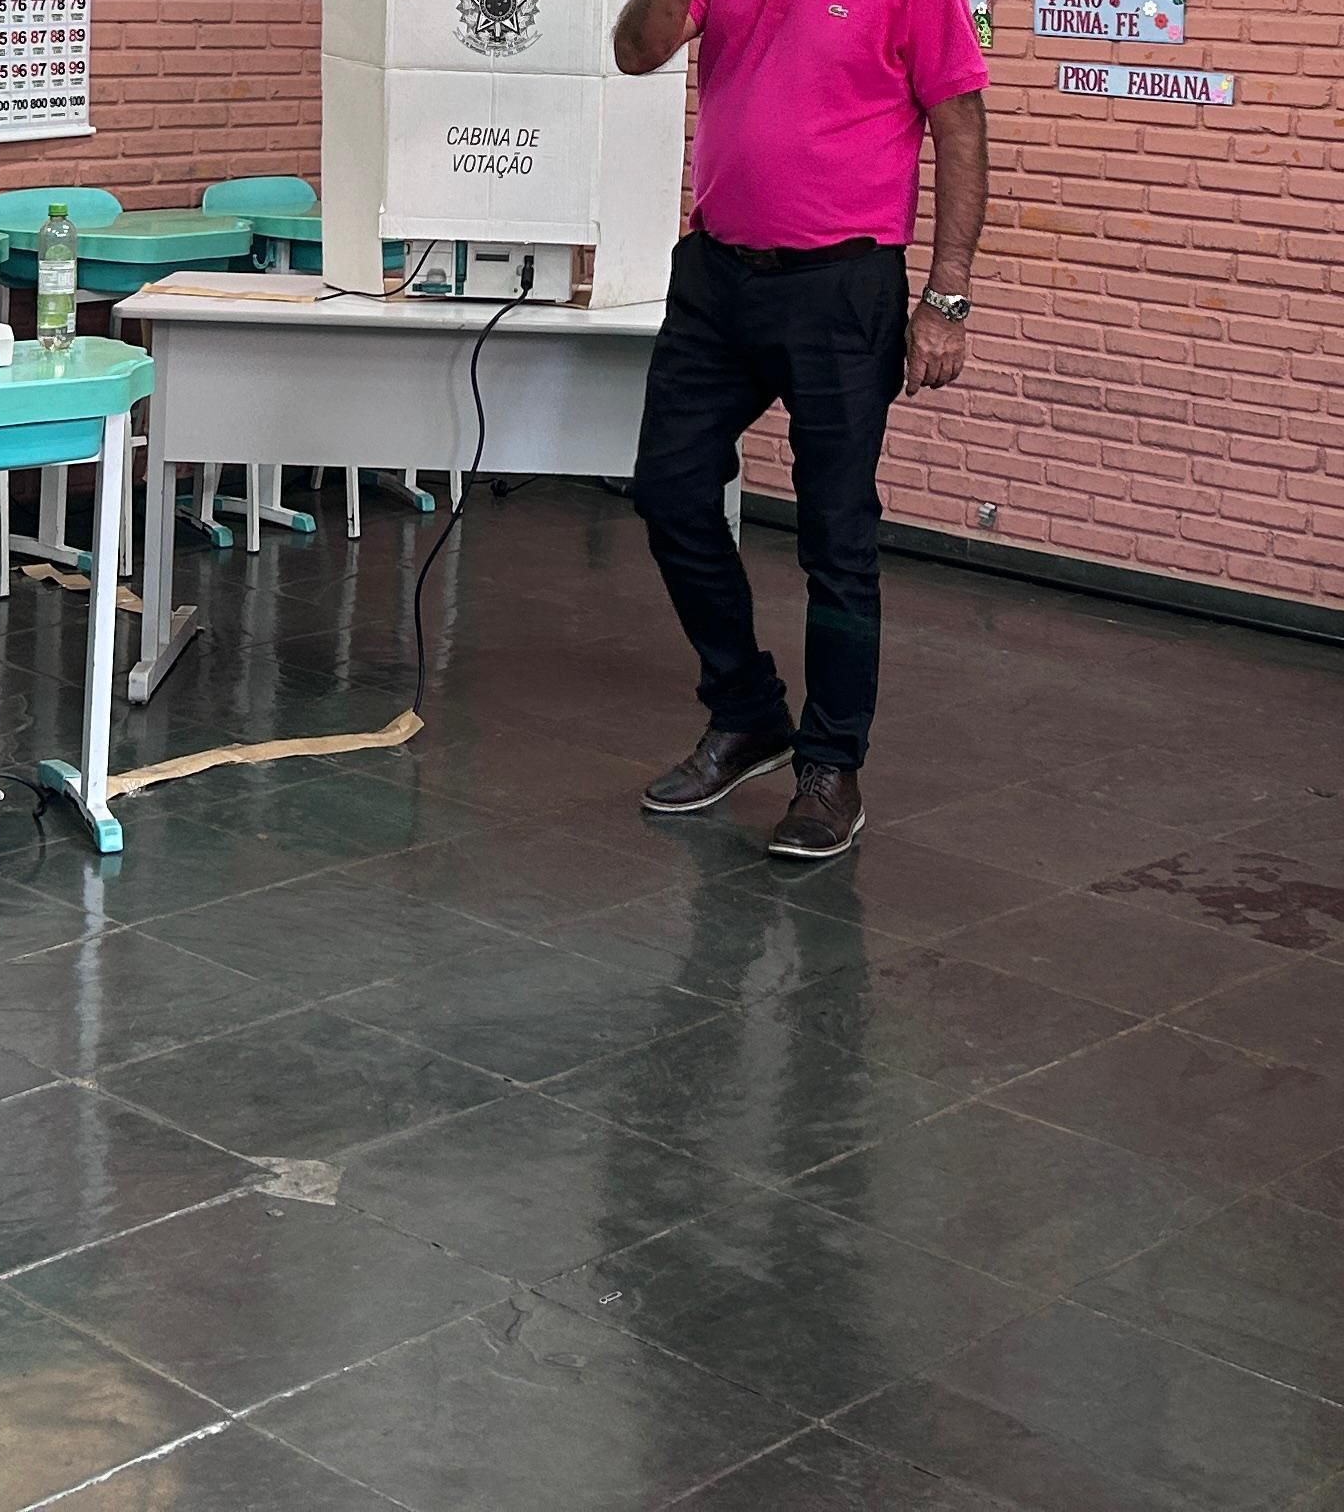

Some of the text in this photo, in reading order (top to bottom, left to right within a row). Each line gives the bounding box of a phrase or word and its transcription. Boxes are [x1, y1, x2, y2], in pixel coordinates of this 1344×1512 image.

[1039, 7, 1140, 37] TURMA: FÉ
[11, 31, 27, 44] 86
[31, 30, 47, 44] 87
[50, 30, 65, 43] 88
[69, 29, 85, 42] 89
[11, 64, 27, 78] 96
[31, 63, 47, 76] 97
[50, 62, 65, 75] 98
[69, 61, 85, 74] 99
[1063, 66, 1211, 101] PROF. FABIANA
[12, 99, 28, 110] 700
[30, 98, 47, 109] 800
[50, 97, 67, 107] 900
[69, 96, 85, 106] 1000
[446, 126, 540, 147] CABINA DE
[453, 152, 533, 179] VOTAÇÃO
